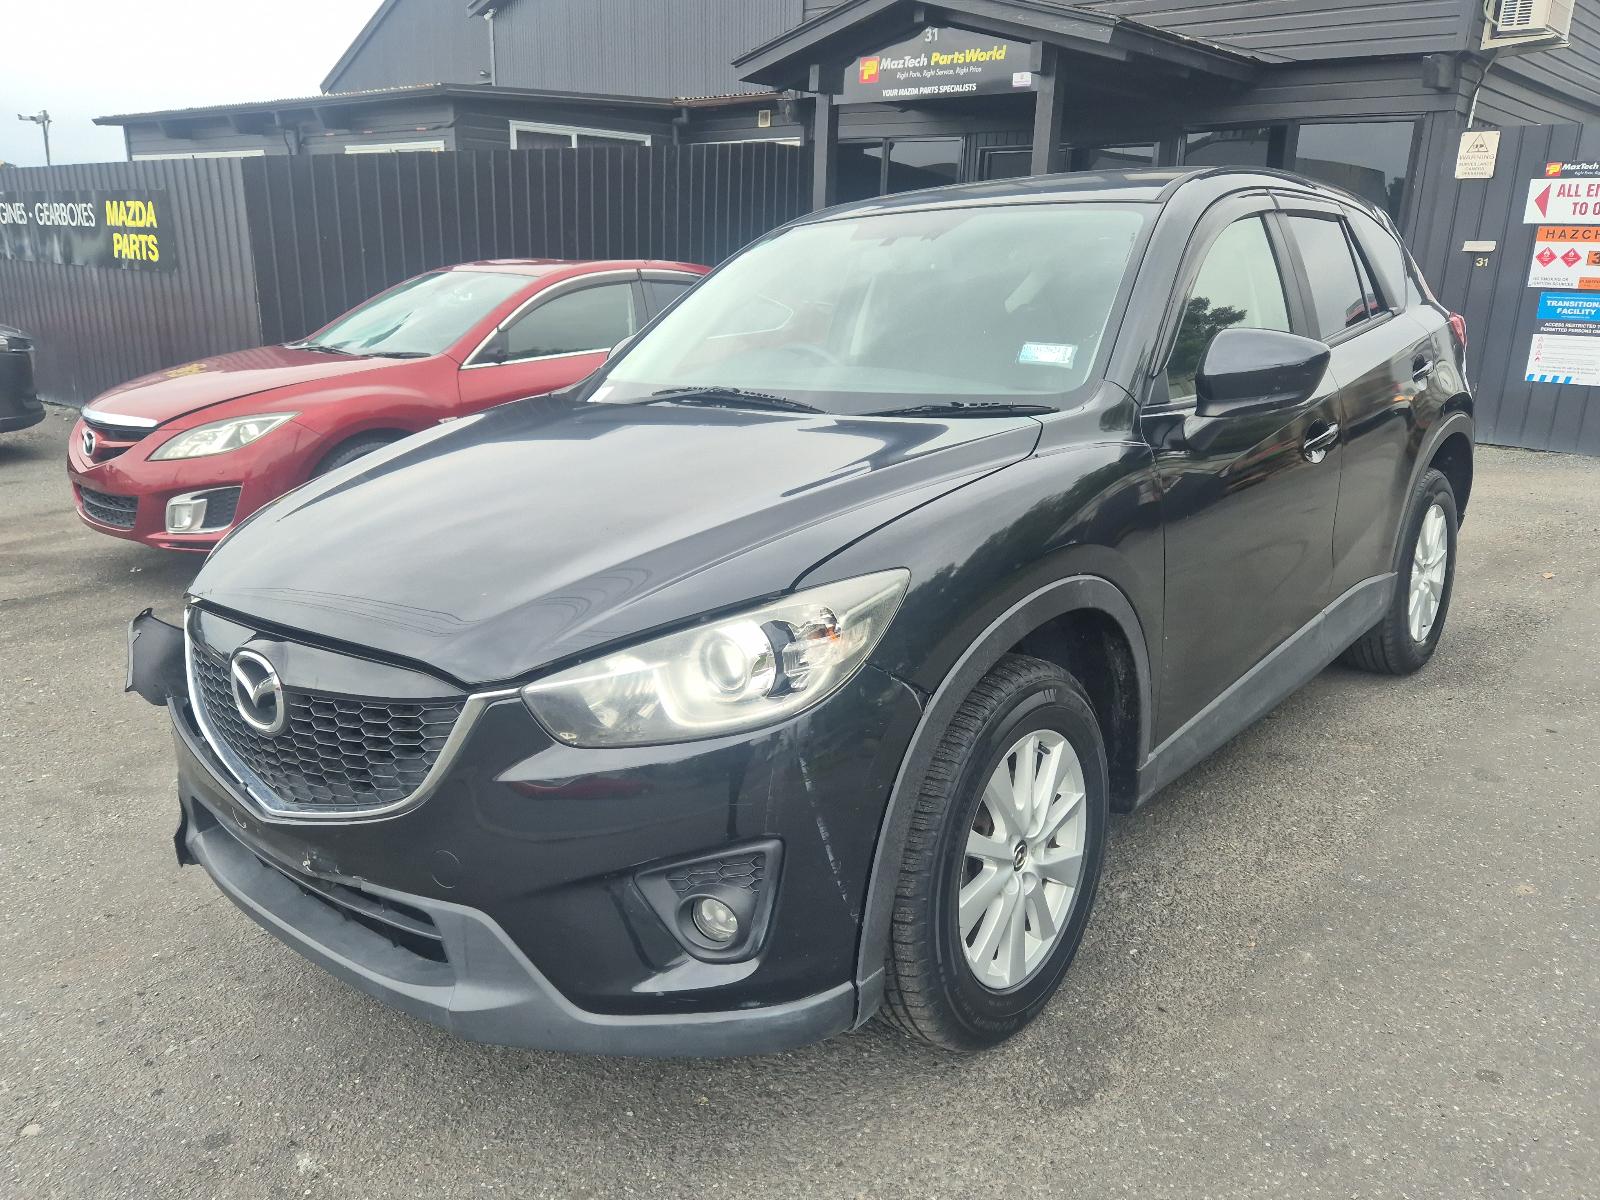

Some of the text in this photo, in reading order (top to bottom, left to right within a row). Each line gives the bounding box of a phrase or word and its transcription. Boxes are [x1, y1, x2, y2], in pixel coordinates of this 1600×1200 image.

[924, 27, 938, 42] 31
[880, 54, 928, 70] MazTech
[930, 45, 1007, 66] PartsWorld
[896, 72, 909, 80] Right
[922, 70, 935, 78] Right
[955, 67, 969, 76] Right
[882, 83, 977, 97] YOUR MAZDA PARTS SPECIALISTS
[1561, 162, 1599, 171] MazTech
[1556, 183, 1582, 198] ALL
[34, 202, 96, 228] GEARBOXES
[105, 199, 158, 229] MAZDA
[1572, 201, 1589, 216] TO
[112, 232, 160, 263] PARTS
[1475, 257, 1489, 267] 31
[1546, 300, 1600, 308] TRANSITION
[1556, 307, 1597, 316] FACILITY
